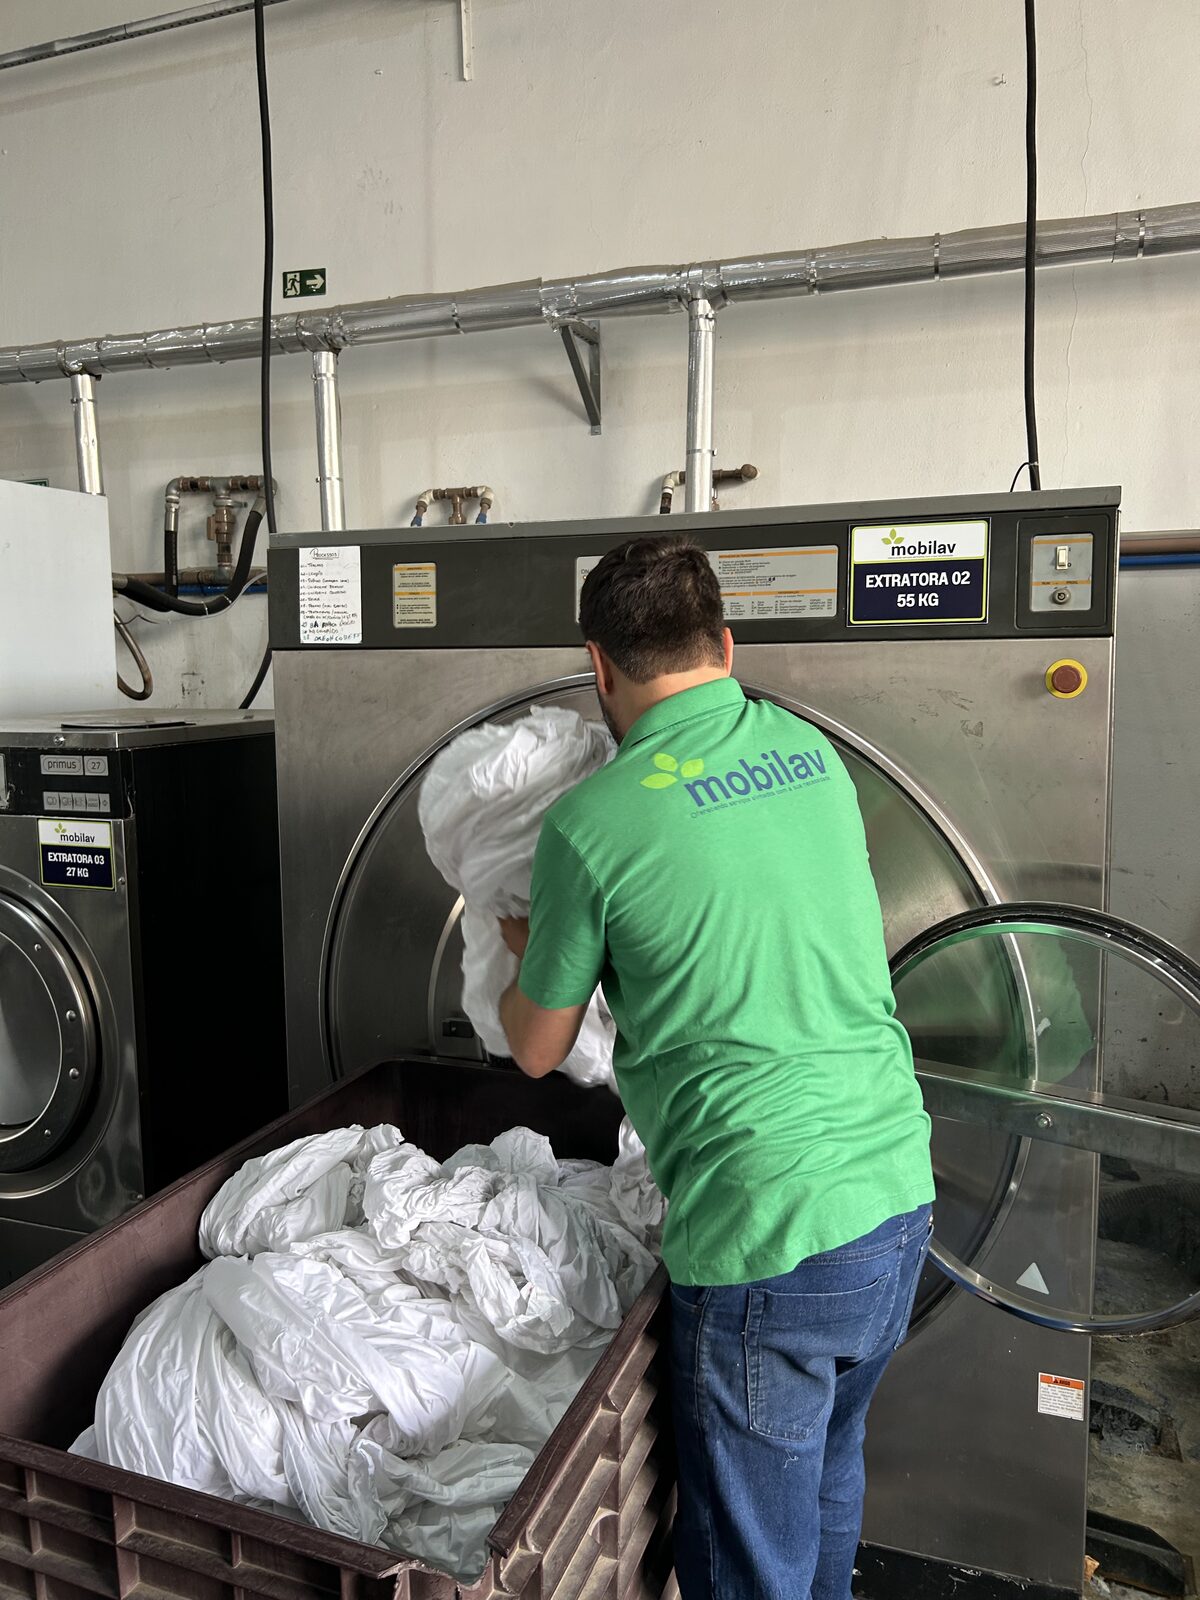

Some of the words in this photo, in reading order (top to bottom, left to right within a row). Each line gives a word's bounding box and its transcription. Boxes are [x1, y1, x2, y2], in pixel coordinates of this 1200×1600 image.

[891, 540, 957, 556] mobilav
[865, 572, 949, 588] EXTRATORA
[951, 571, 971, 585] 02
[896, 593, 916, 608] 55
[918, 592, 939, 607] KG
[47, 760, 77, 770] primus
[91, 761, 101, 770] 27
[684, 749, 826, 807] mobilav
[60, 833, 95, 843] mobilav
[47, 851, 93, 864] EXTRATORA
[94, 855, 105, 865] 03
[66, 867, 76, 877] 27
[77, 868, 89, 878] KG
